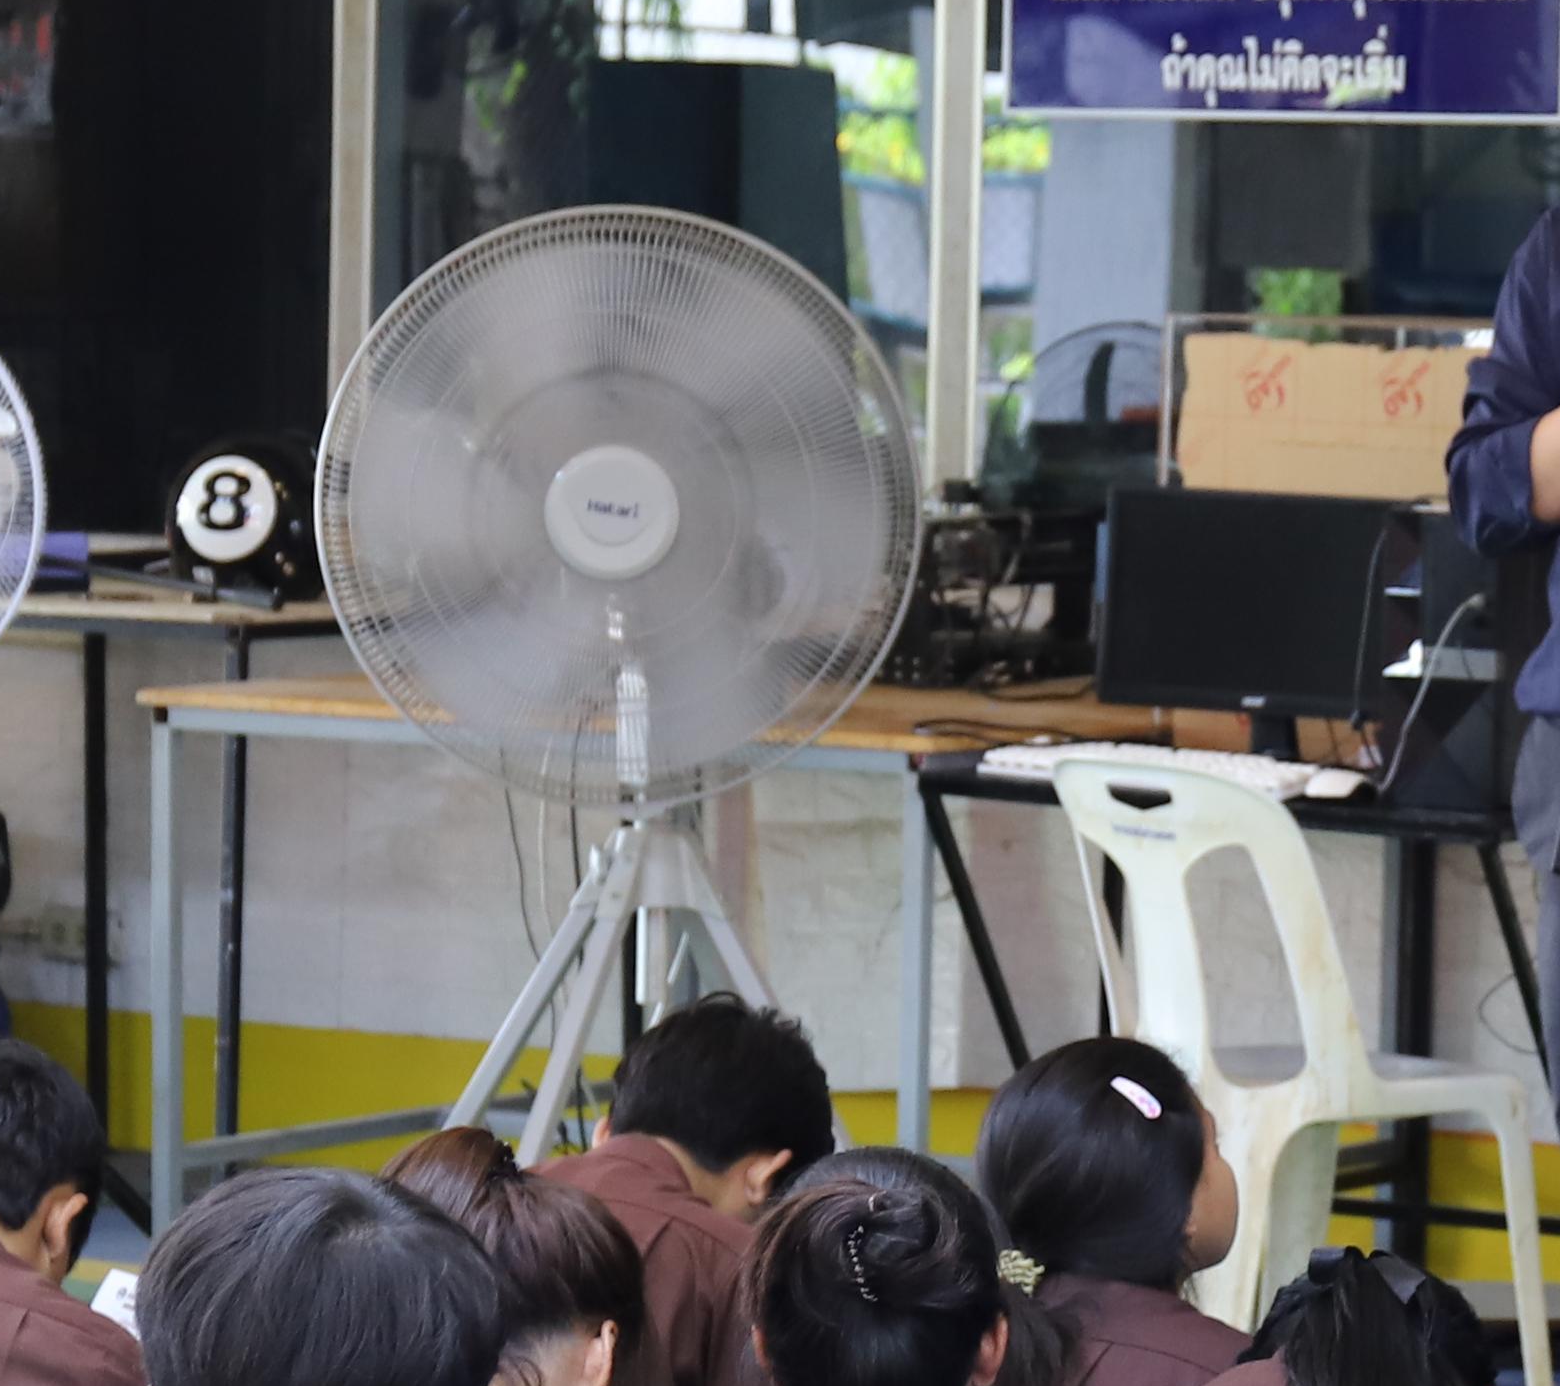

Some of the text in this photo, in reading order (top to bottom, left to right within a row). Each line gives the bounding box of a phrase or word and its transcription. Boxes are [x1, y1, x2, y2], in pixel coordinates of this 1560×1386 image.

[1161, 26, 1407, 107] ถ้าคุณไม่คิดจะเริ่ม
[197, 471, 251, 531] 8
